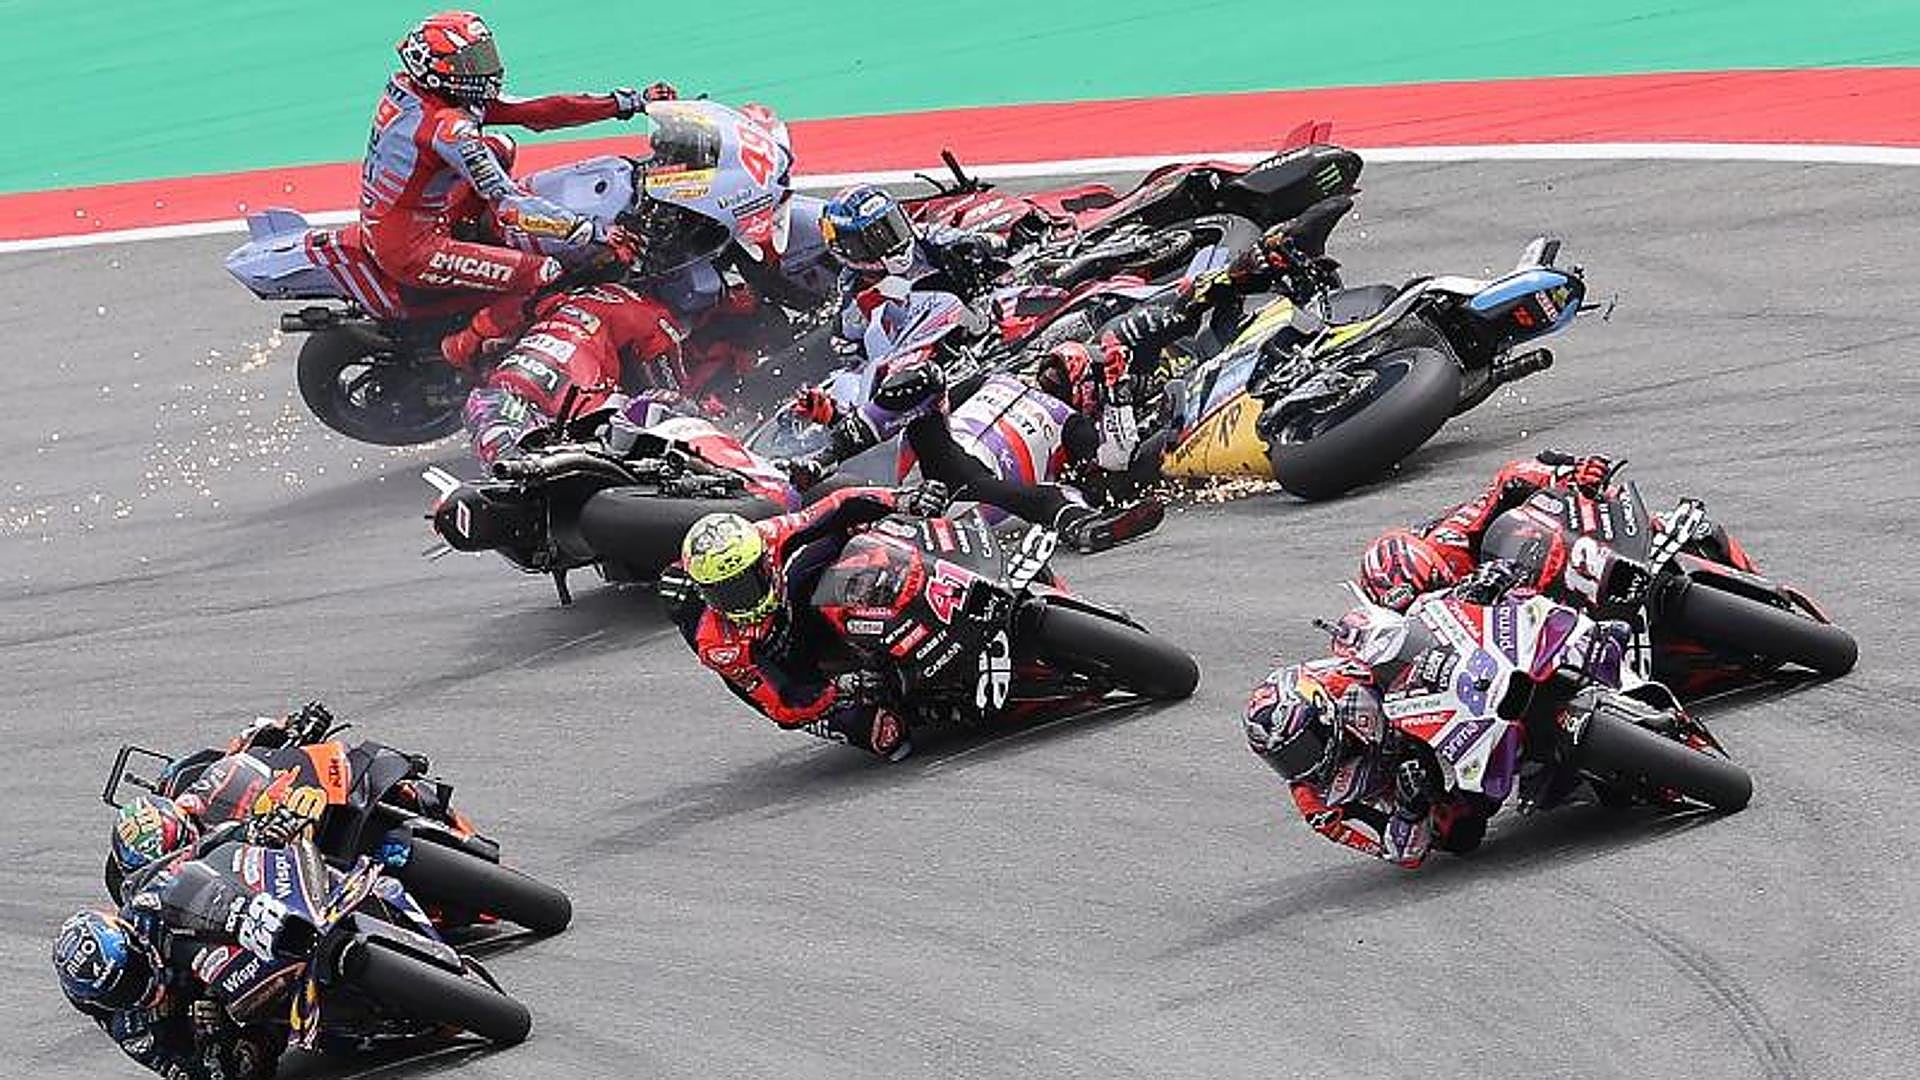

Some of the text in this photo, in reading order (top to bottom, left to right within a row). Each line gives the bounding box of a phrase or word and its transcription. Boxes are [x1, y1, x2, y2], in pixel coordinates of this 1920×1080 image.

[429, 252, 513, 281] DUCATI
[926, 559, 973, 625] 41
[1563, 535, 1601, 606] 12
[1499, 600, 1515, 652] prima
[1443, 724, 1480, 763] prima
[275, 850, 293, 899] Wispr
[222, 957, 260, 993] Wispr
